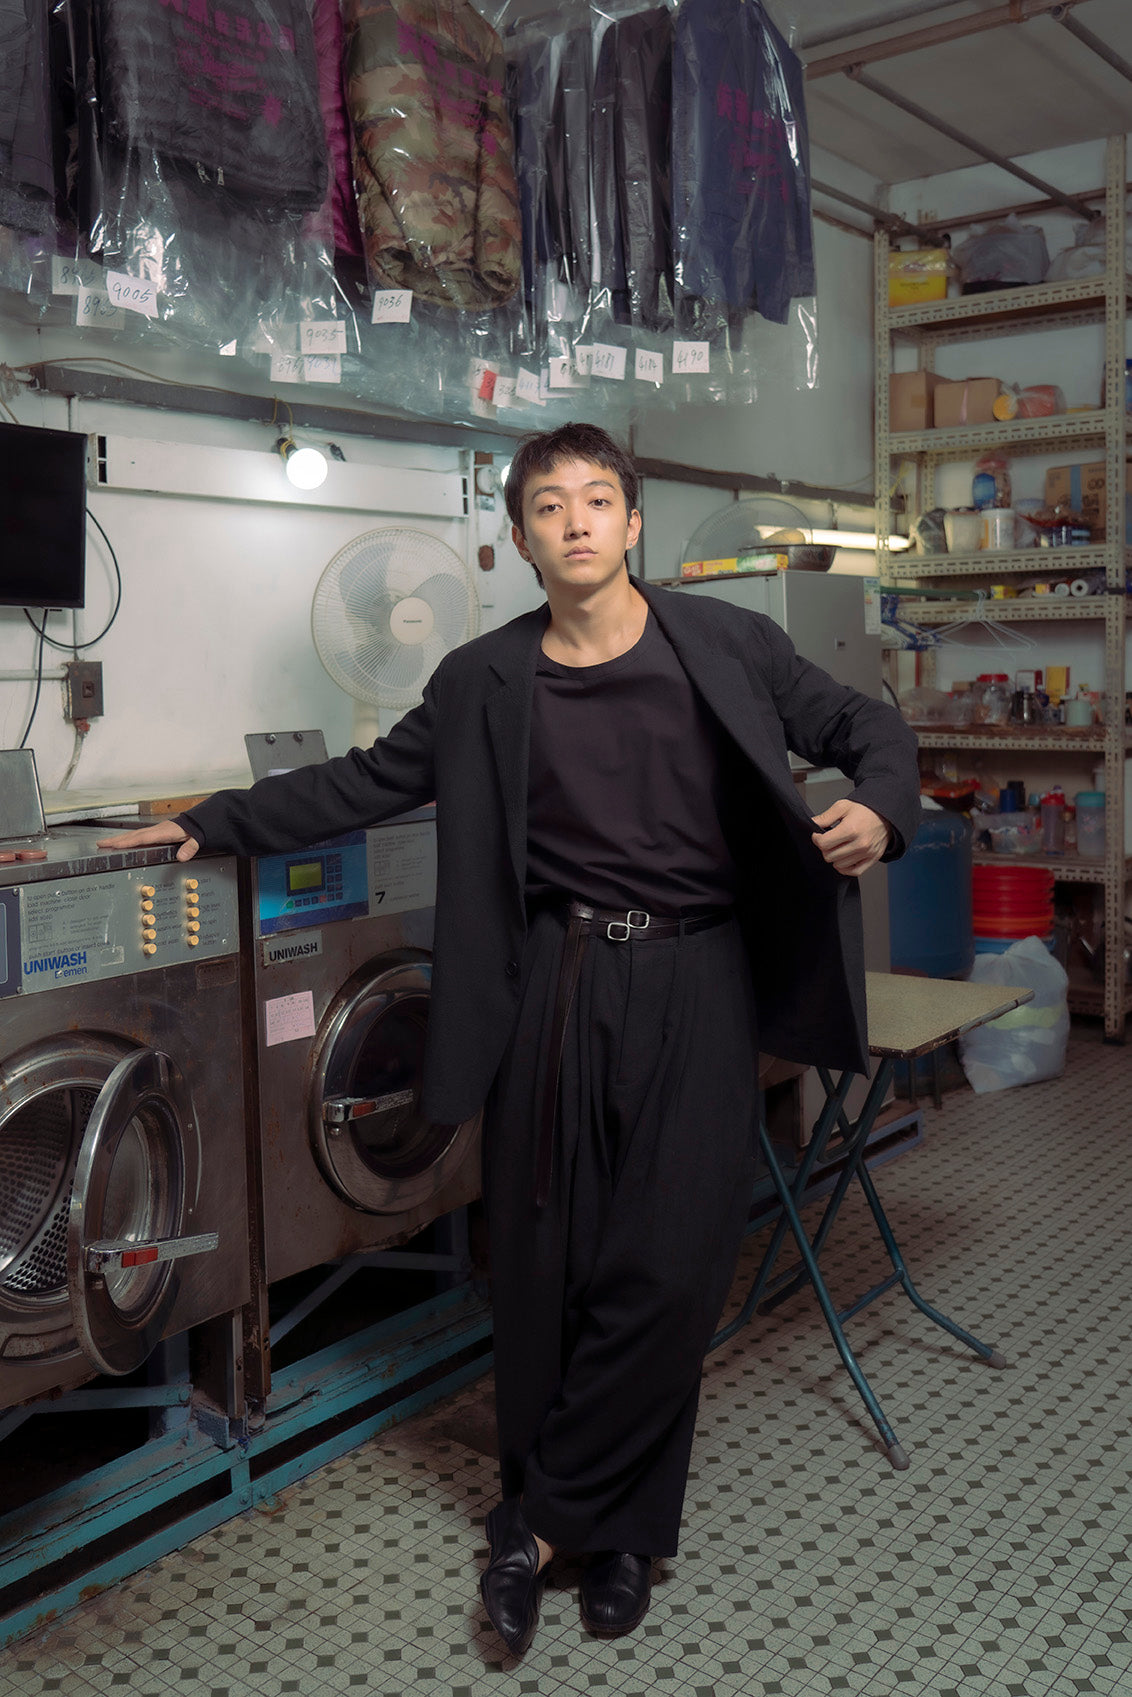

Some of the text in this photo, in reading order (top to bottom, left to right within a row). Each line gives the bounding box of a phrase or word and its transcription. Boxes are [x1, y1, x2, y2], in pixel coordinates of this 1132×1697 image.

[112, 282, 154, 303] 9005
[375, 891, 386, 904] 7
[269, 942, 318, 961] UNIWASH
[24, 951, 87, 975] UNIWASH
